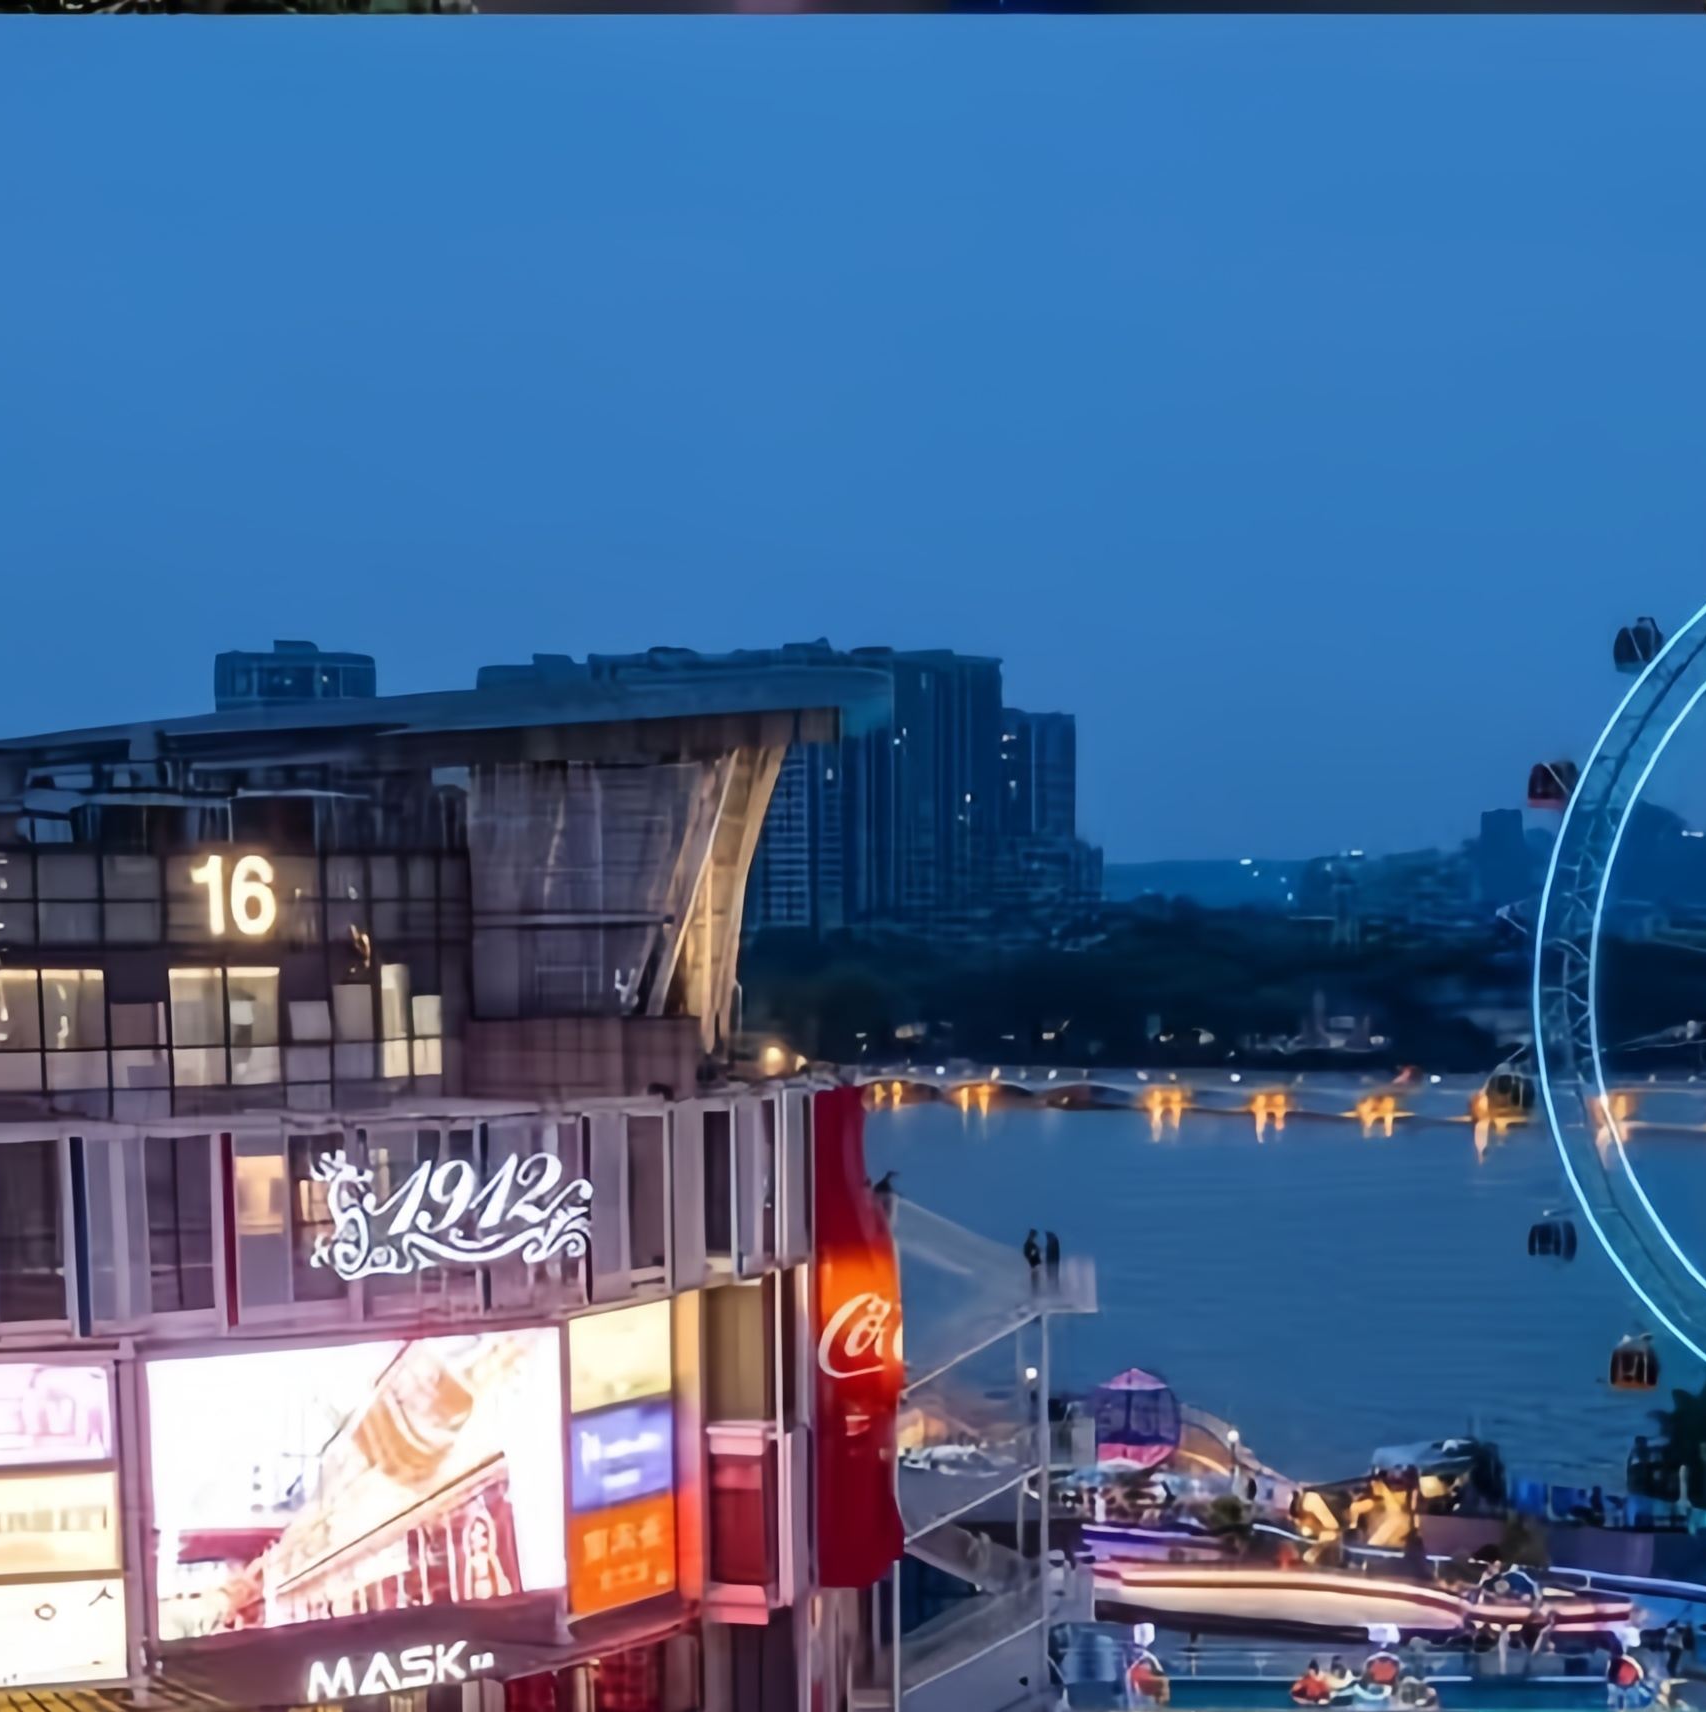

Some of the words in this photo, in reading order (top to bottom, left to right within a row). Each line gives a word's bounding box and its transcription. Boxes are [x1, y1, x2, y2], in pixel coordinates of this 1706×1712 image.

[191, 854, 277, 936] 16
[364, 1152, 593, 1235] 1912
[308, 1640, 468, 1704] MASK
